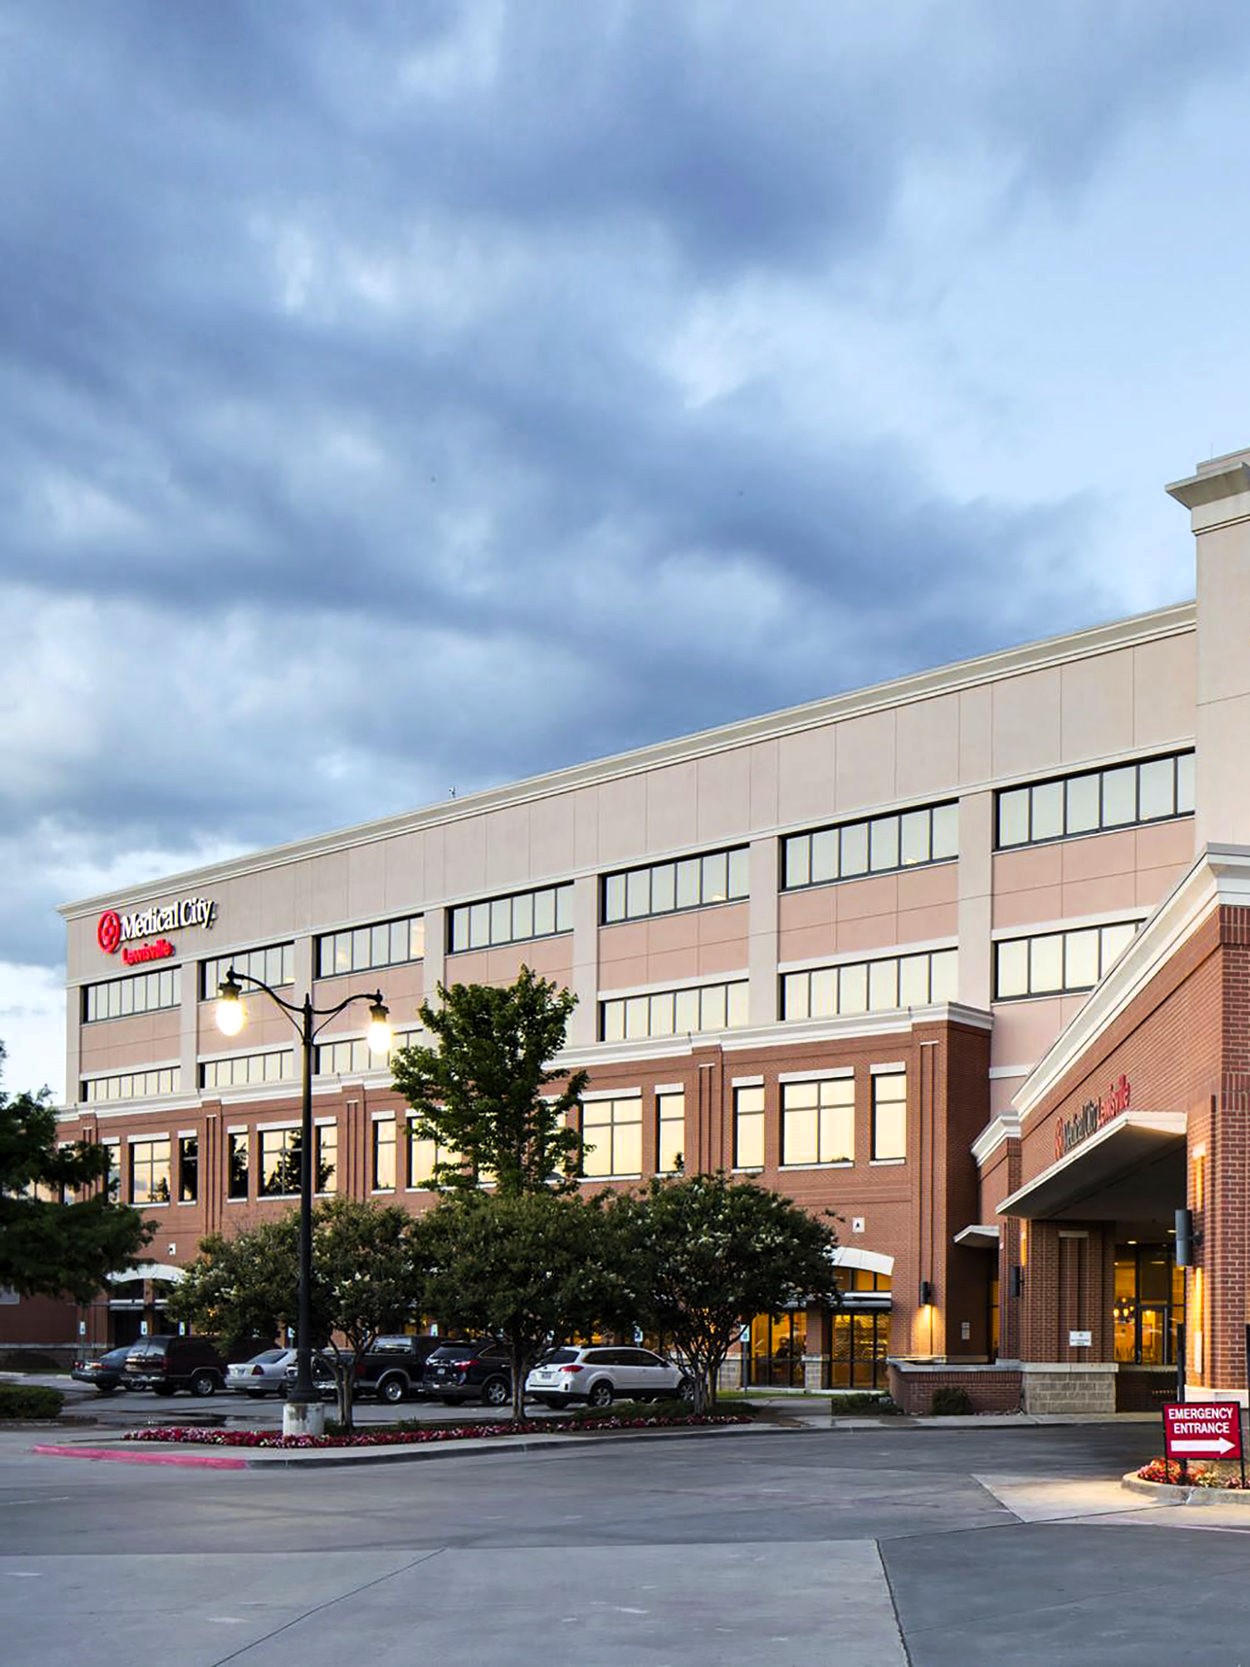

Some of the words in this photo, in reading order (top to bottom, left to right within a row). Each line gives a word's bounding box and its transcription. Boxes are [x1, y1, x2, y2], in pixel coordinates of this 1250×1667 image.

[120, 901, 180, 941] Medical
[180, 897, 214, 929] City
[122, 938, 174, 966] Lewisville
[1168, 1407, 1234, 1420] EMERGENCY
[1173, 1421, 1231, 1434] ENTRANCE
